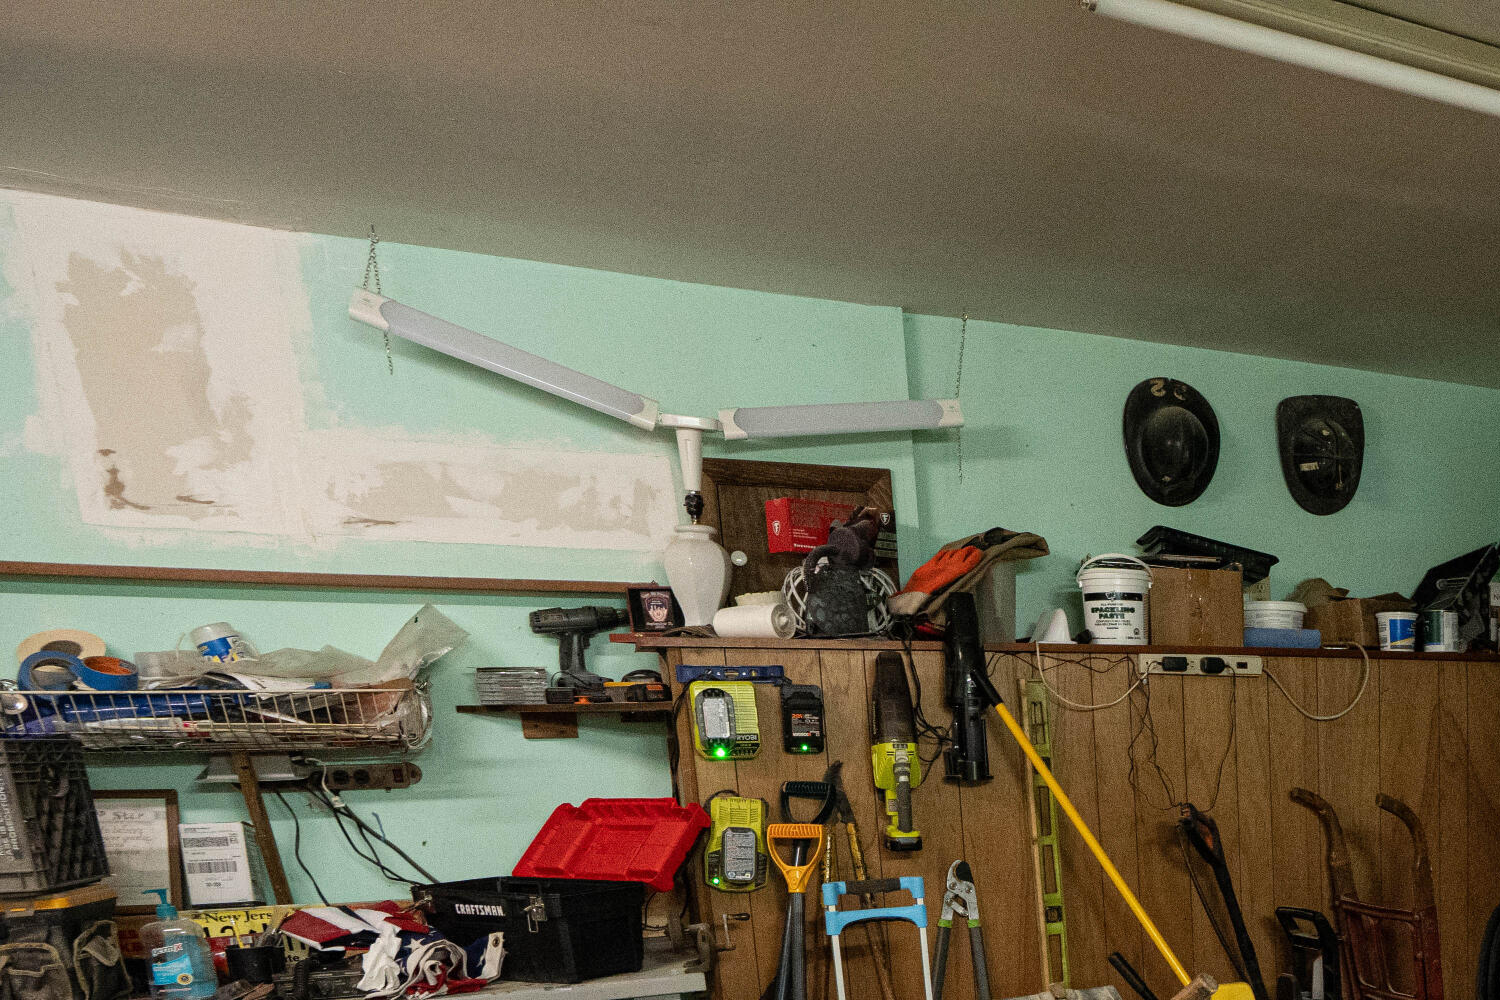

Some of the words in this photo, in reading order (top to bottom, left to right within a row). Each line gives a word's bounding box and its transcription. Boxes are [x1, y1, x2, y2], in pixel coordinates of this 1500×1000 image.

[455, 904, 505, 917] CRAFTSMAN
[203, 912, 240, 923] New
[244, 911, 272, 922] Jers
